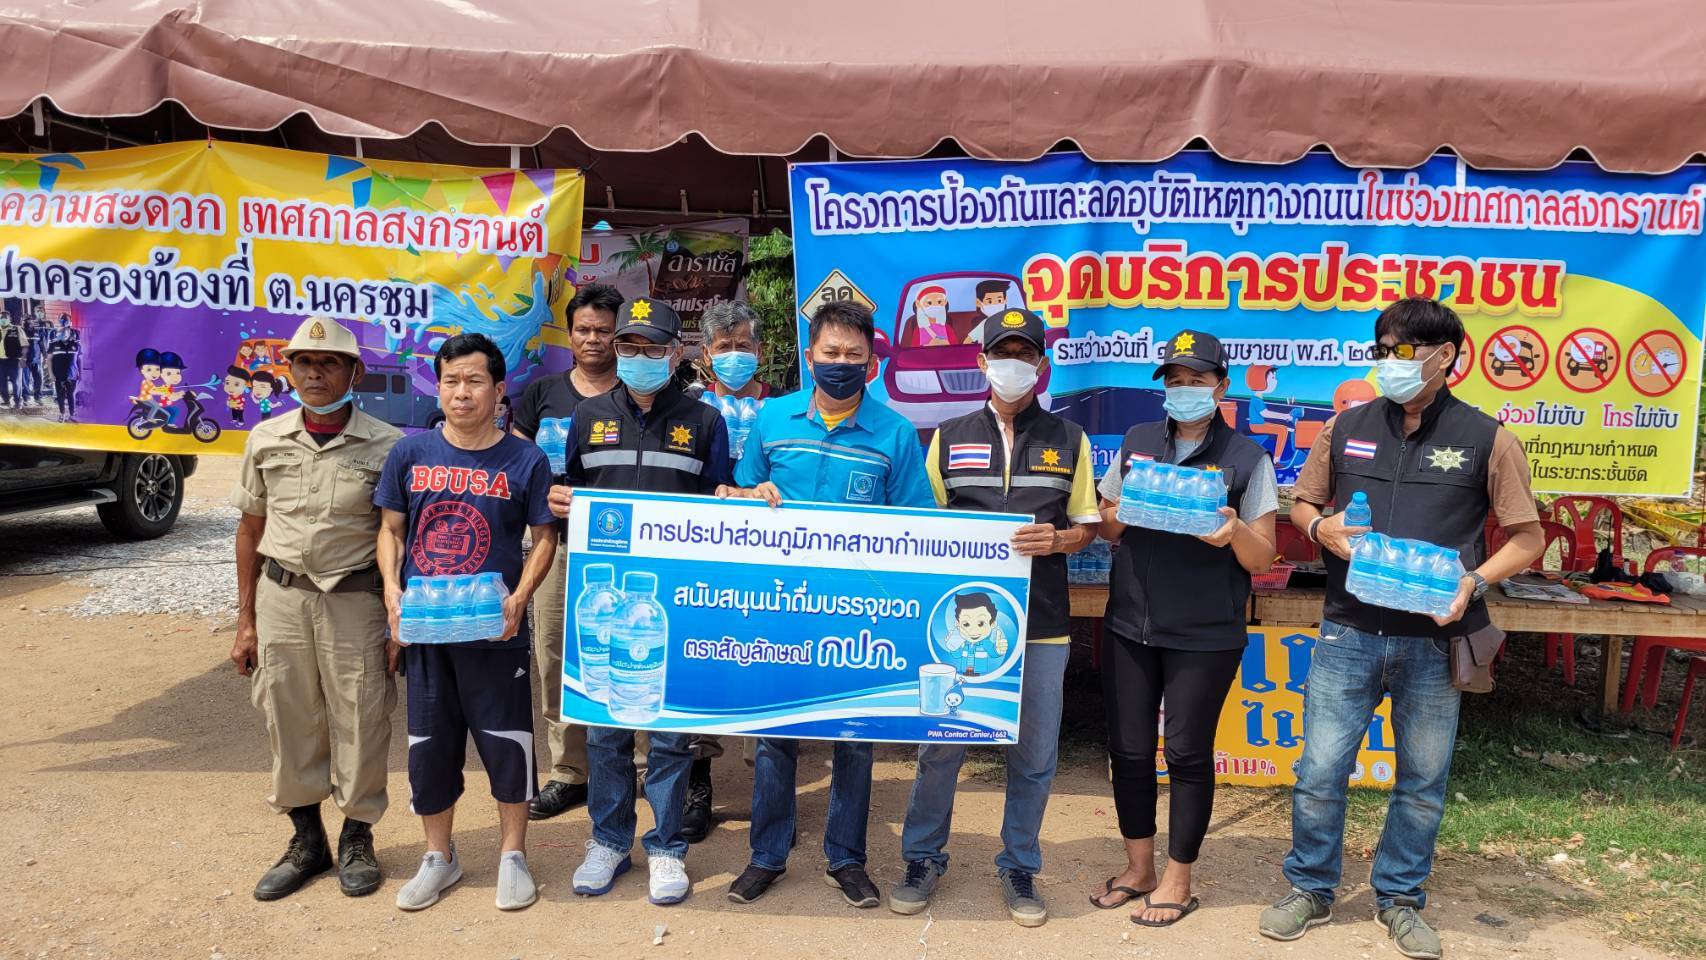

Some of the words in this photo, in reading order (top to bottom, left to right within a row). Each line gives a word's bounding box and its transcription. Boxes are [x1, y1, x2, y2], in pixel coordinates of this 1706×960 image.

[1, 192, 221, 232] ความสะดวก
[244, 200, 546, 255] เทศกาลสงกรานต์
[1026, 243, 1561, 319] จุดบริการประชาชน
[269, 279, 428, 334] ต.นครชุม
[1057, 331, 1149, 360] ระหว่างวันที่
[1223, 343, 1288, 361] มษายน
[1297, 344, 1338, 361] พ.ศ.
[1497, 401, 1585, 426] ง่วงไม่ขับ
[1603, 404, 1679, 428] โทรไม่ขับ
[639, 520, 1010, 561] การประปาส่วนภูมิภาคสาขากำแพงเพชร
[674, 579, 920, 620] สนับสนุนน้ำดื่มบรรจุขวด
[685, 637, 809, 666] ตราสัญลักษณ์
[818, 628, 907, 671] กปภ.
[927, 730, 943, 738] PWA
